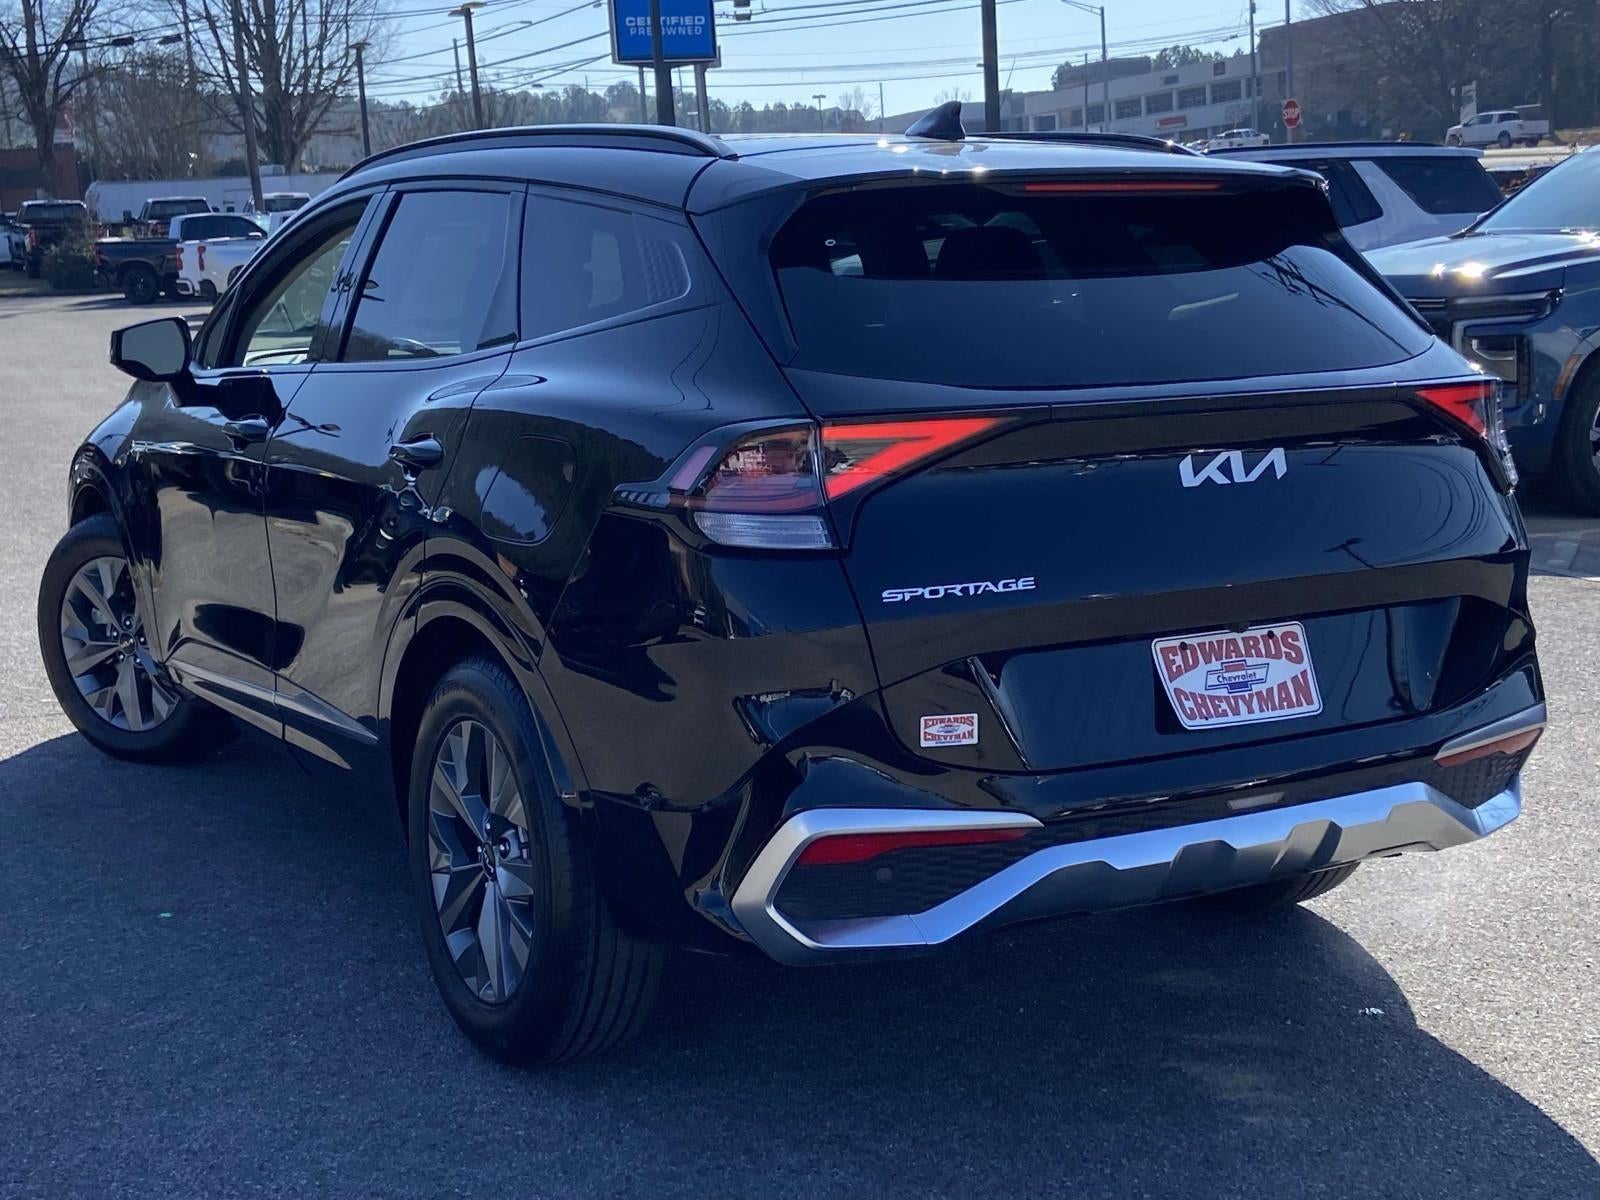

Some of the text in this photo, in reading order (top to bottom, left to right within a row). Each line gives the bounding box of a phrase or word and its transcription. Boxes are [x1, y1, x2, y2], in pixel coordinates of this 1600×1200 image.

[630, 26, 653, 36] PRE
[1282, 107, 1299, 119] STOP
[1179, 447, 1287, 488] KIA
[881, 576, 1036, 603] SPORTAGE
[1159, 630, 1305, 683] EDWARDS
[1216, 671, 1257, 684] Chevrolet
[1173, 668, 1314, 721] CHEVYMAN
[923, 716, 975, 729] EDWARDS
[923, 728, 974, 742] CHEVYMAN
